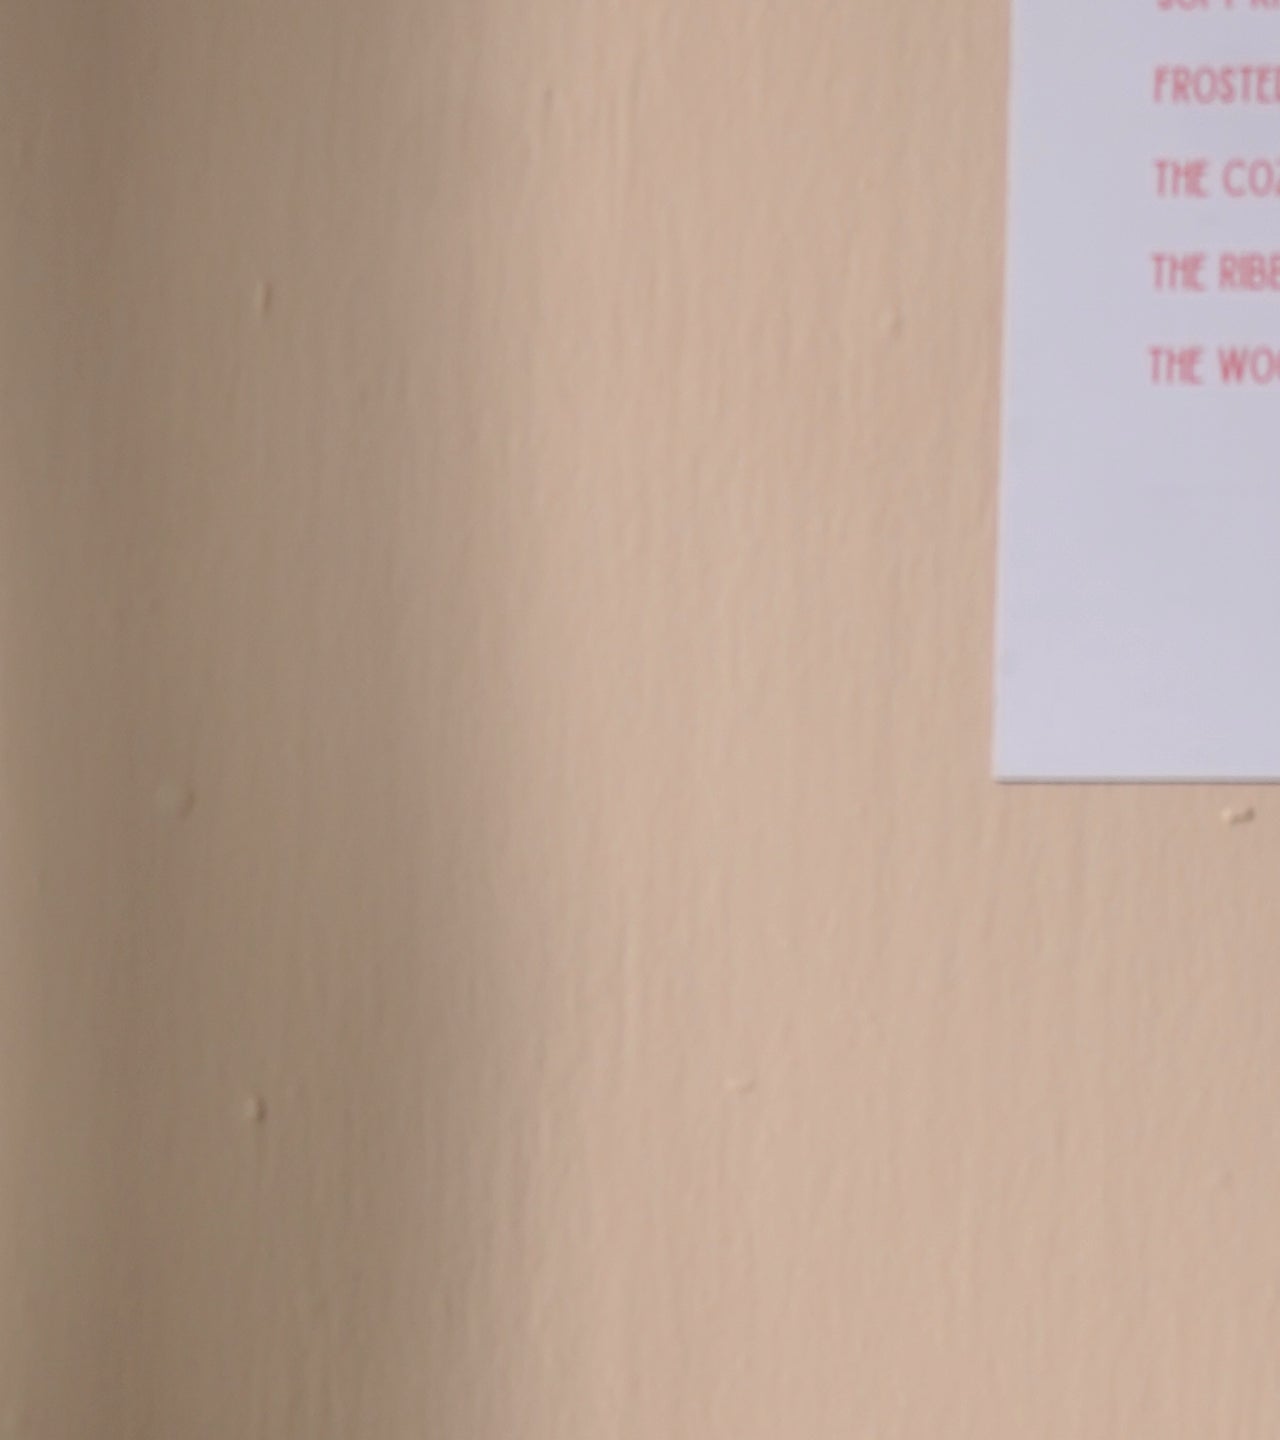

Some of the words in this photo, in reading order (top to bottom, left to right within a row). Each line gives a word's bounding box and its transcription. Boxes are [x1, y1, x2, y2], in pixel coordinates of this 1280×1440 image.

[1153, 64, 1280, 104] FROSTE
[1154, 159, 1209, 198] THE
[1222, 158, 1280, 198] CO
[1151, 252, 1206, 291] THE
[1149, 345, 1203, 385] THE
